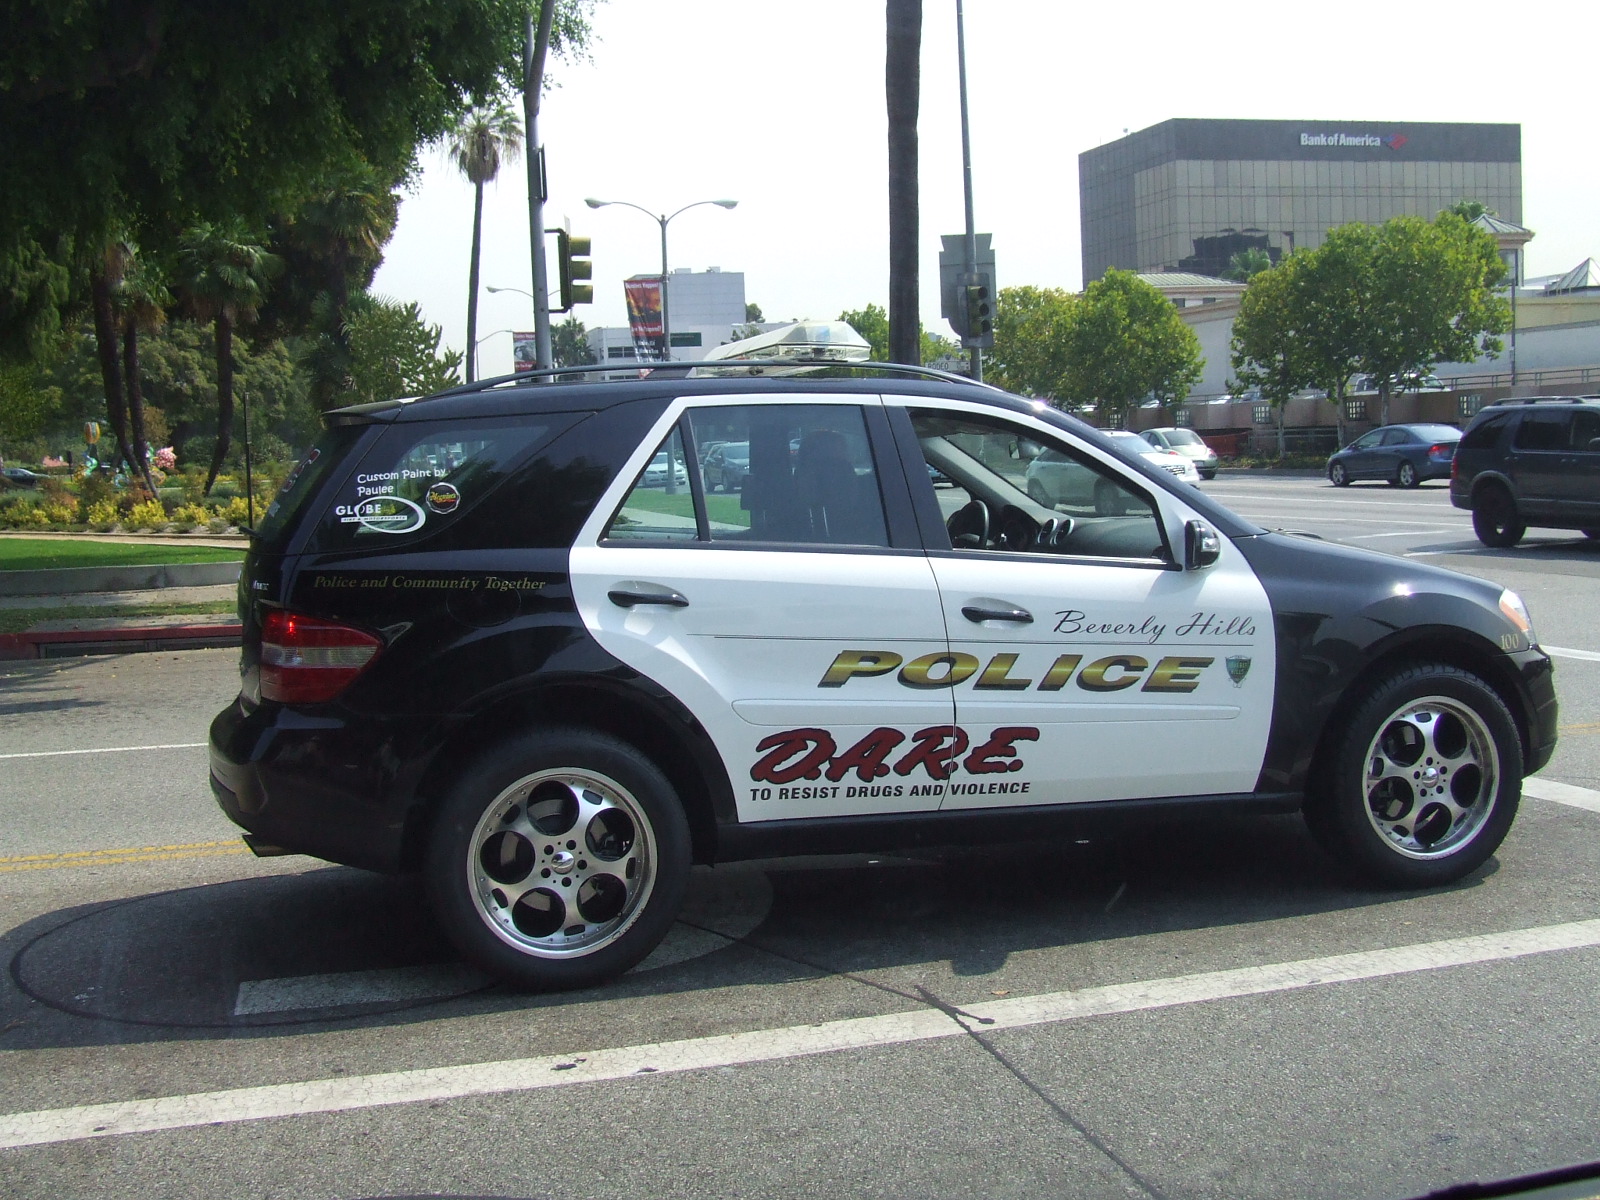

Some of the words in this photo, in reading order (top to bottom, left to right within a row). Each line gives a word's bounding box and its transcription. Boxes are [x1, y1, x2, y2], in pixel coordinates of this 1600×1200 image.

[1300, 133, 1328, 146] Bank
[1328, 133, 1339, 146] of
[1339, 133, 1381, 147] America
[357, 472, 399, 484] Custom
[401, 469, 432, 480] Paint
[433, 467, 447, 478] by
[357, 485, 394, 497] Paulee
[335, 504, 382, 516] GLOBE
[313, 576, 357, 588] Police
[360, 576, 388, 588] and
[392, 576, 480, 591] Community
[484, 576, 546, 591] Together
[1053, 610, 1168, 644] Beverly
[1175, 611, 1256, 637] Hills
[1500, 633, 1519, 650] 100
[817, 649, 1215, 693] POLICE
[750, 788, 772, 801] TO
[778, 786, 840, 800] RESIST
[846, 785, 904, 798] DRUGS
[909, 784, 944, 797] AND
[950, 782, 1031, 795] VIOLENCE
